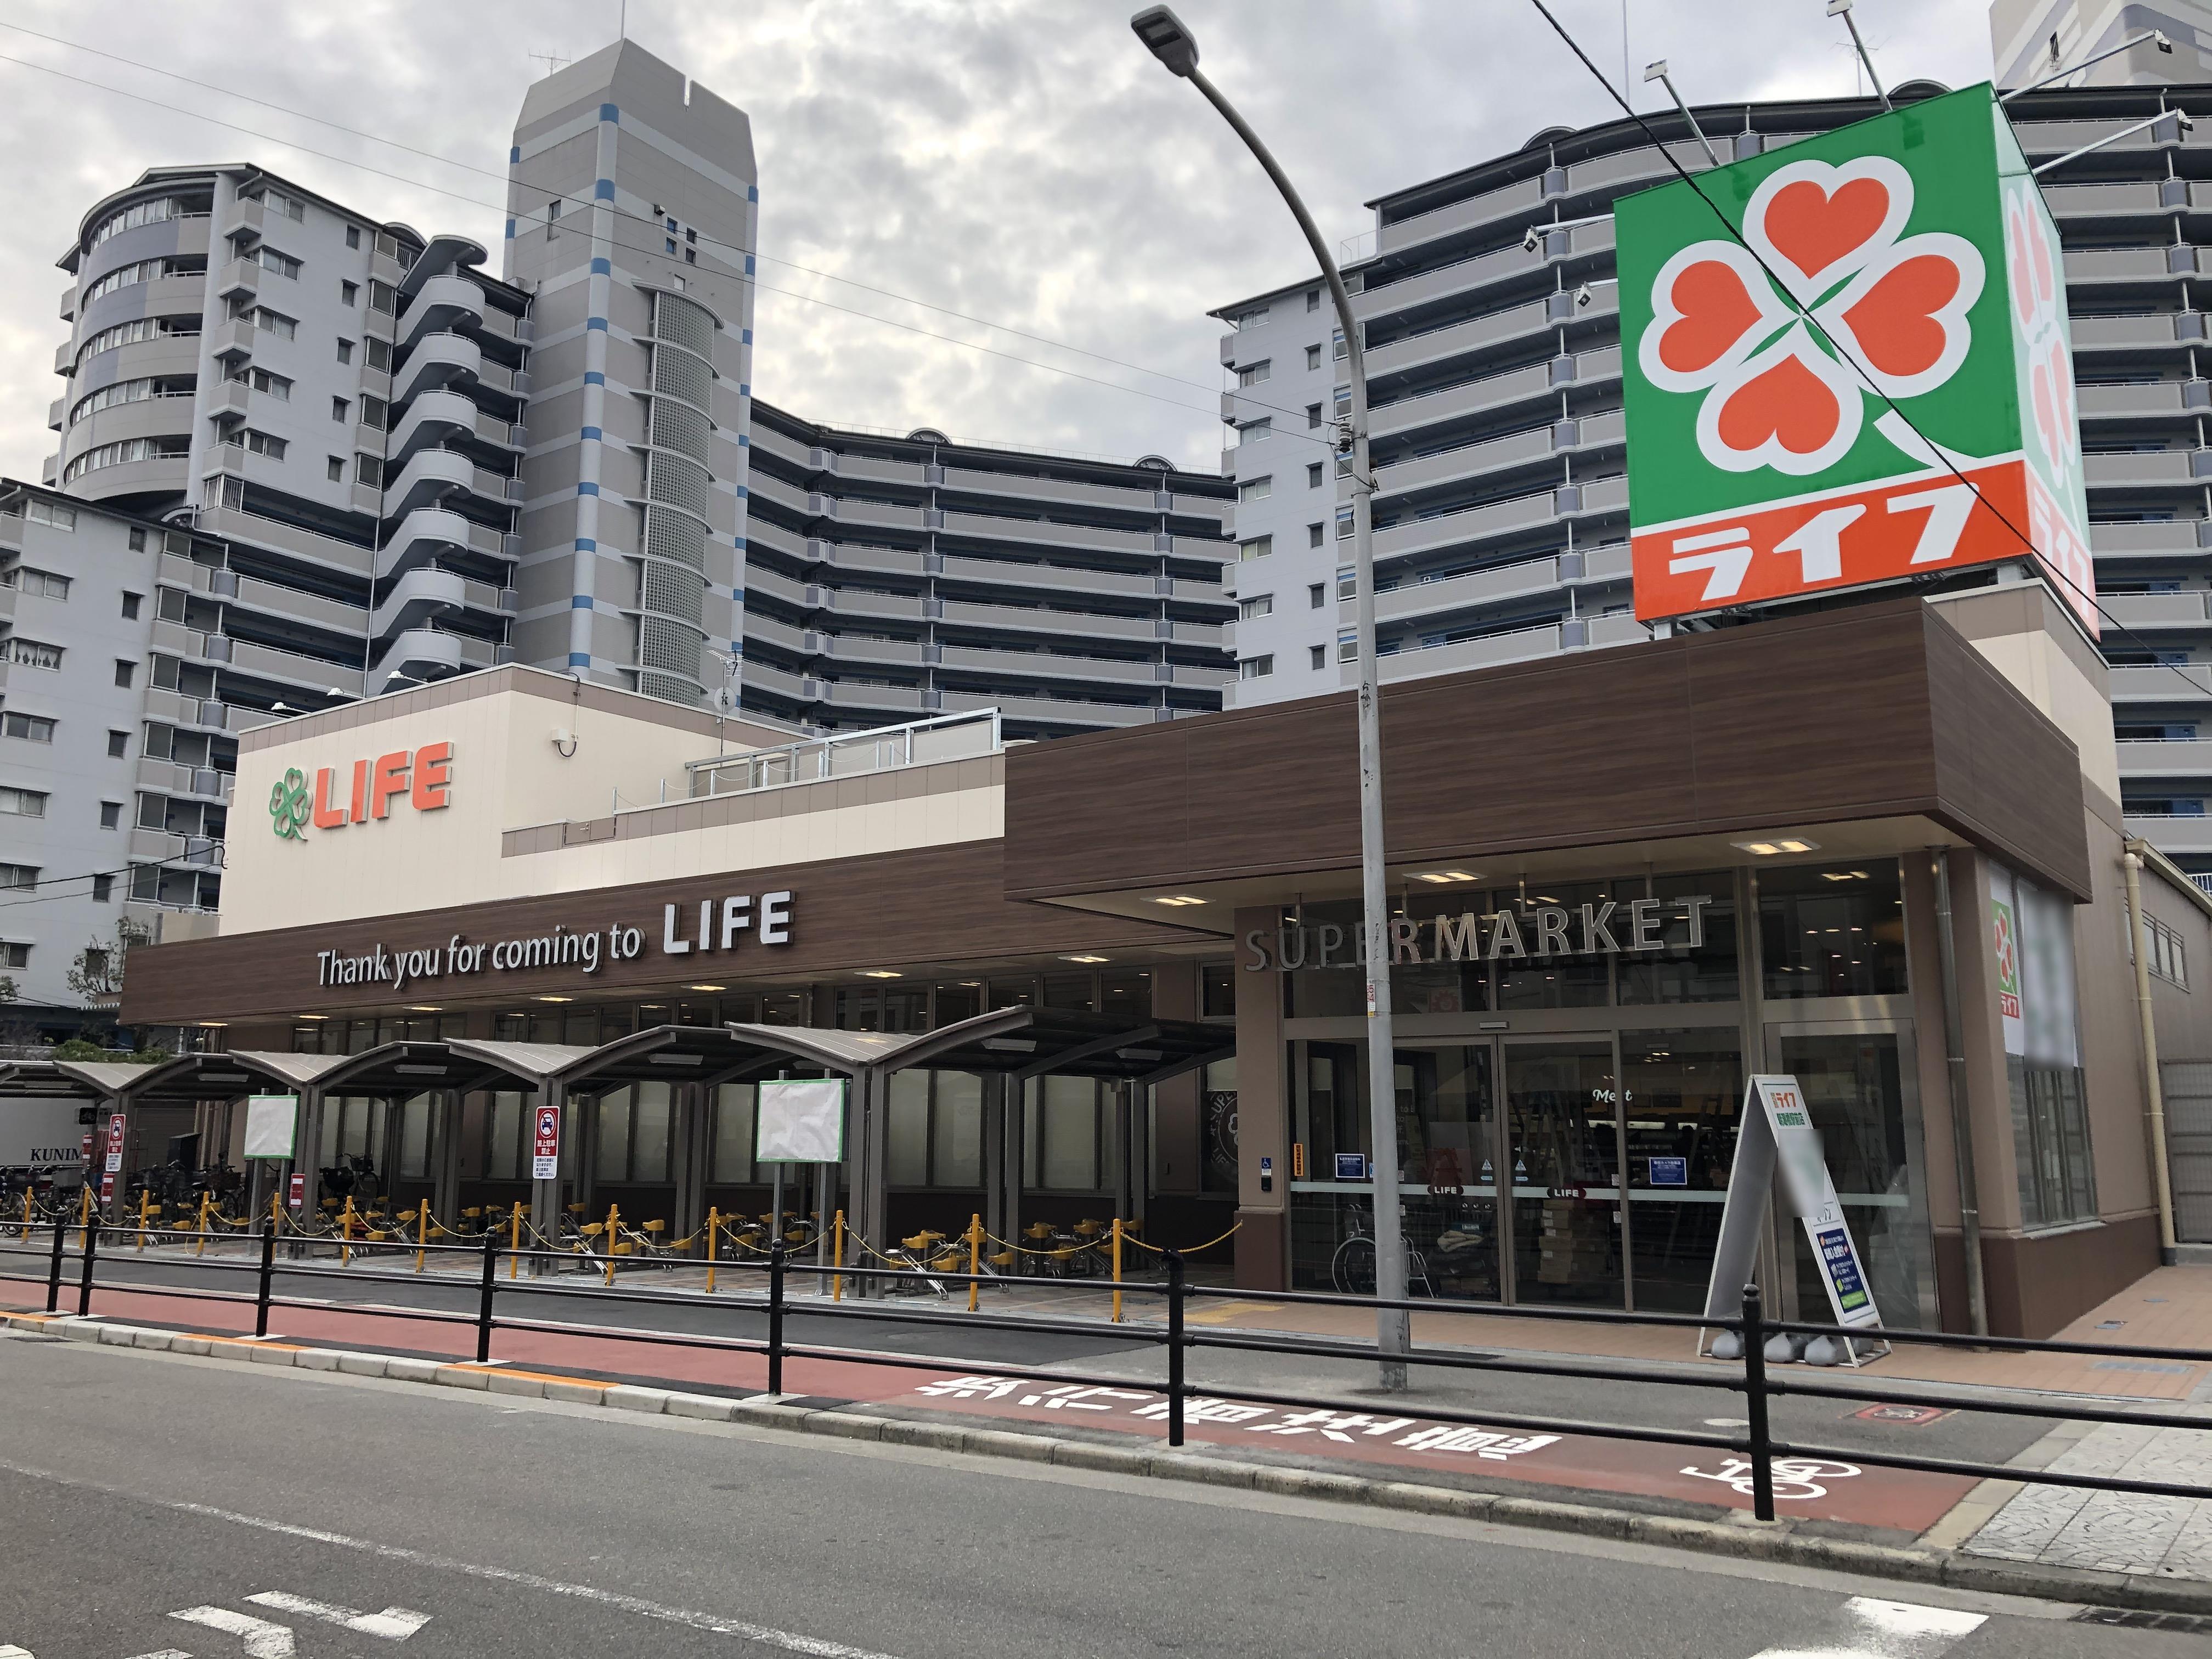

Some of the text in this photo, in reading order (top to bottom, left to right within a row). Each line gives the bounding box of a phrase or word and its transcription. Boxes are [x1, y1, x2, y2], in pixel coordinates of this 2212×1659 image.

[1669, 483, 1980, 601] ライフ
[2034, 485, 2089, 618] ライフ
[314, 741, 454, 829] LIFE
[318, 890, 793, 990] Thank you for coming to LIFE
[2001, 995, 2017, 1016] ライフ
[1593, 1089, 1633, 1103] Met
[1775, 1092, 1797, 1108] ライフ
[1434, 1186, 1457, 1194] LIFE
[1554, 1189, 1579, 1198] LIFE
[915, 1376, 1562, 1460] 歩行者注意
